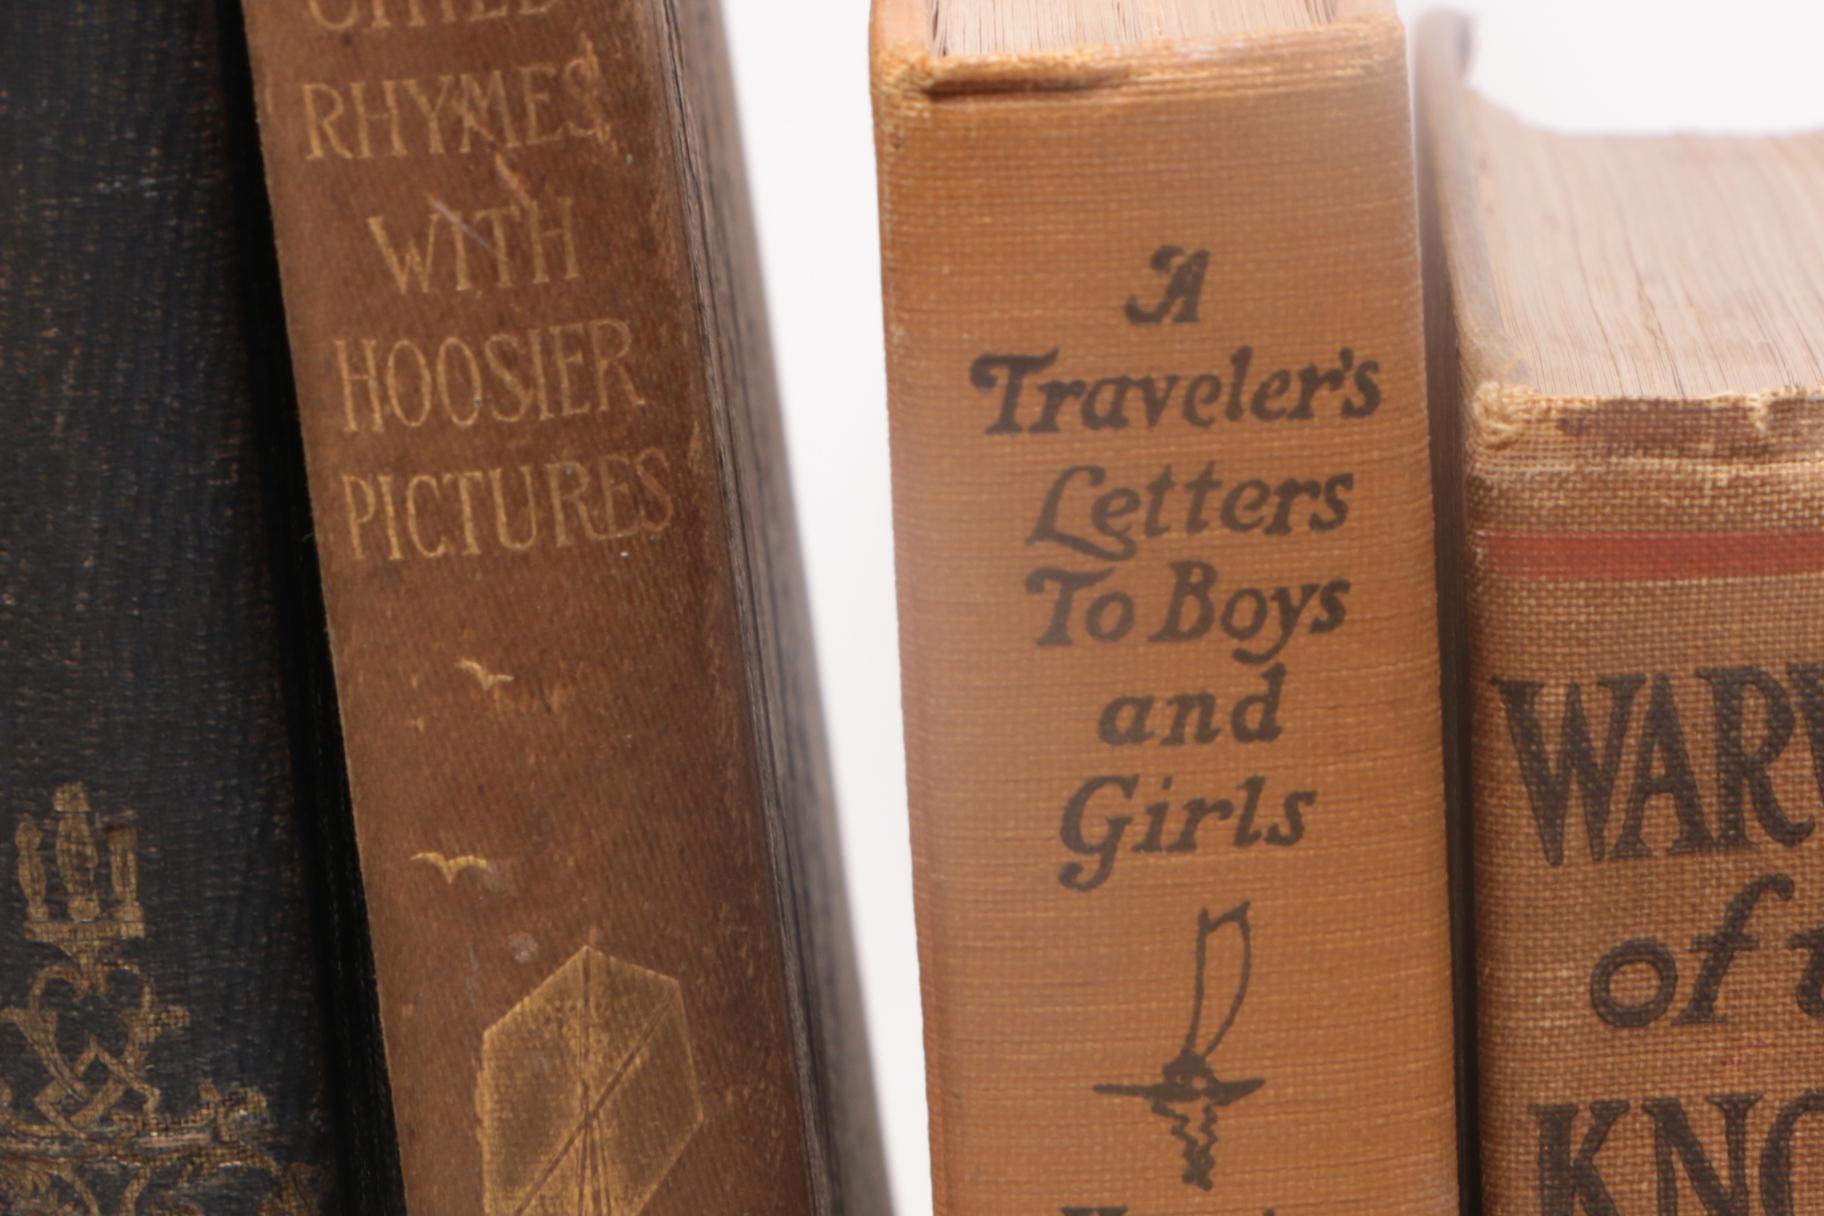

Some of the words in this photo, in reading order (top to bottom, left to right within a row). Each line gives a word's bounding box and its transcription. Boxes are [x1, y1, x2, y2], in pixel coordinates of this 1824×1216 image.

[302, 58, 606, 160] RHYMES
[368, 197, 580, 294] WITH
[1125, 245, 1211, 326] A
[334, 318, 646, 432] HOOSIER
[968, 345, 1383, 437] Traveler's
[342, 446, 675, 561] PICTURES
[1025, 460, 1355, 562] Letters
[1024, 565, 1135, 648] To
[1147, 560, 1352, 665] Boys
[1098, 662, 1287, 747] and
[1058, 773, 1318, 892] Girls
[1589, 874, 1795, 1030] of
